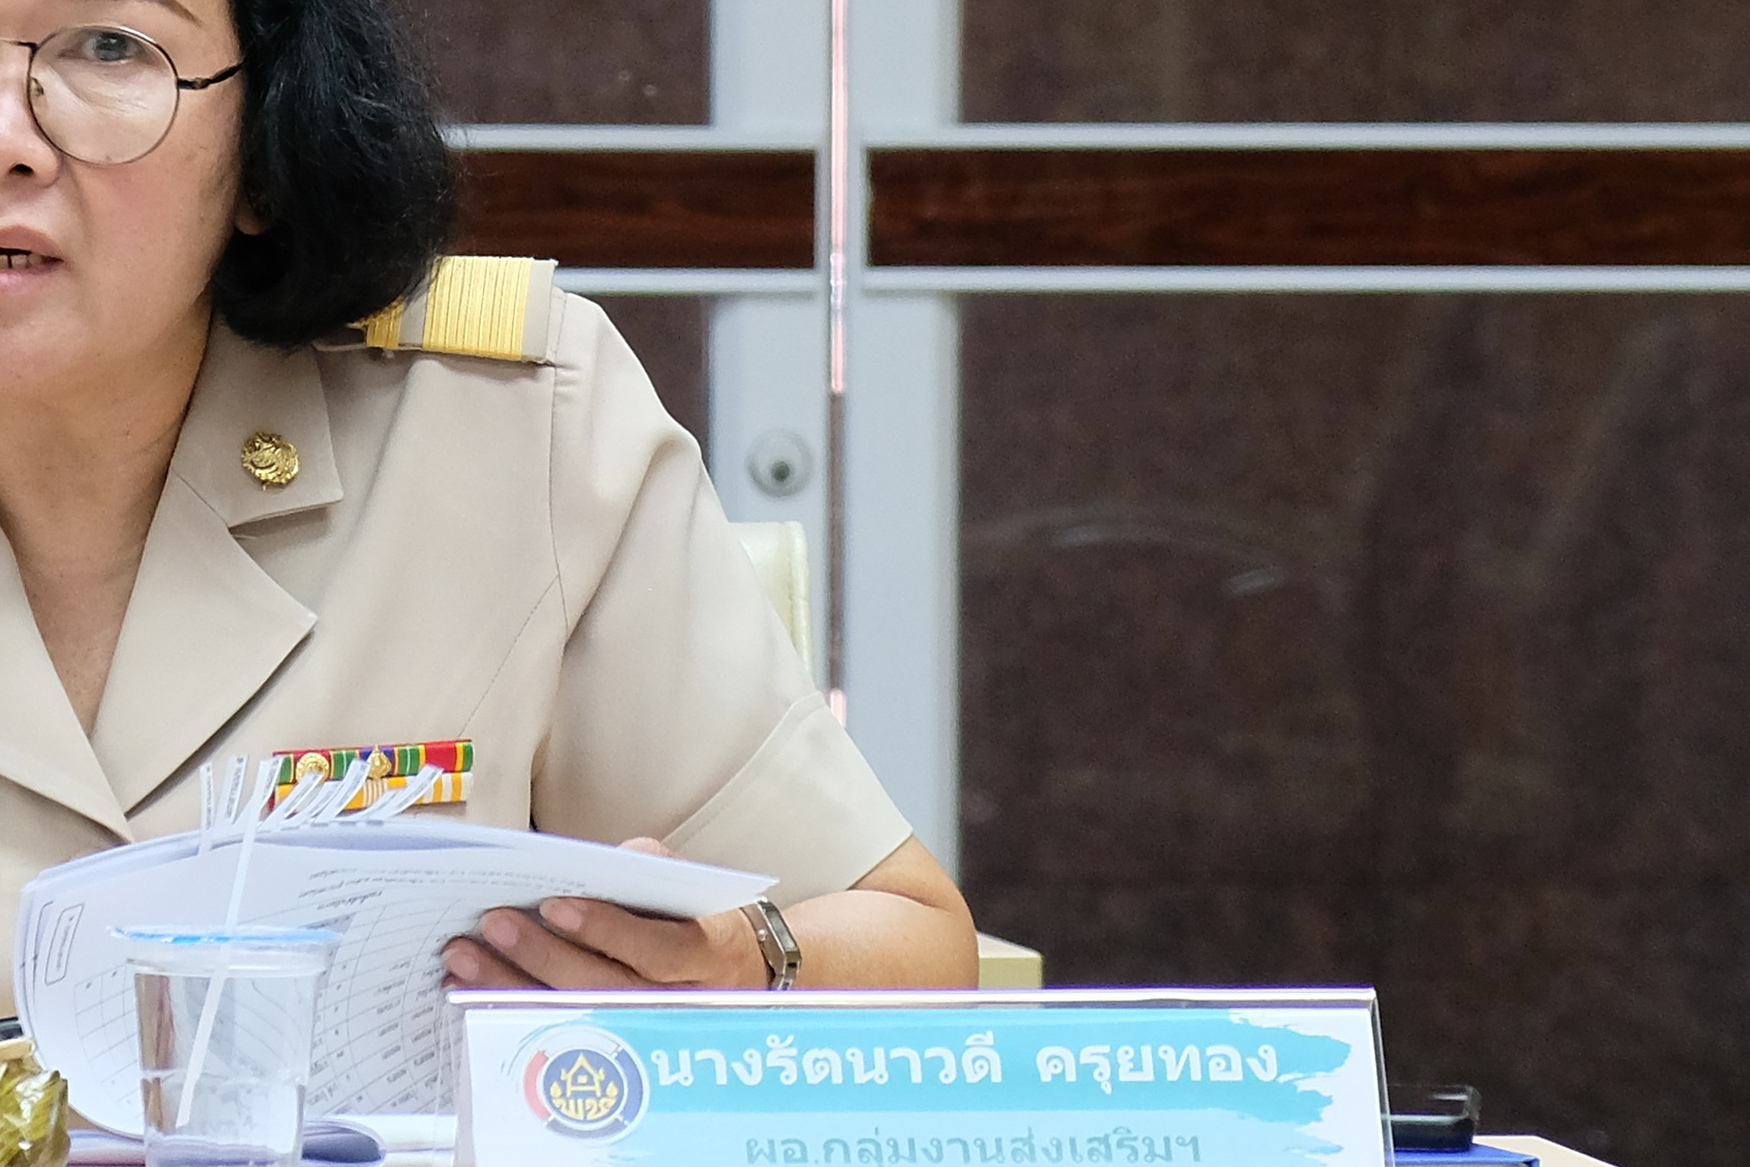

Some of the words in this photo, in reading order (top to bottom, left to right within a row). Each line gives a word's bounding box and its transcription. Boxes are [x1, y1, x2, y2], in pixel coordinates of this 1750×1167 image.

[650, 1030, 1003, 1086] นางรัตนาวดี
[1035, 1044, 1279, 1095] ครุยทอง
[746, 1125, 1202, 1167] ผอ.กล่มงานส่งเสริมฯ
